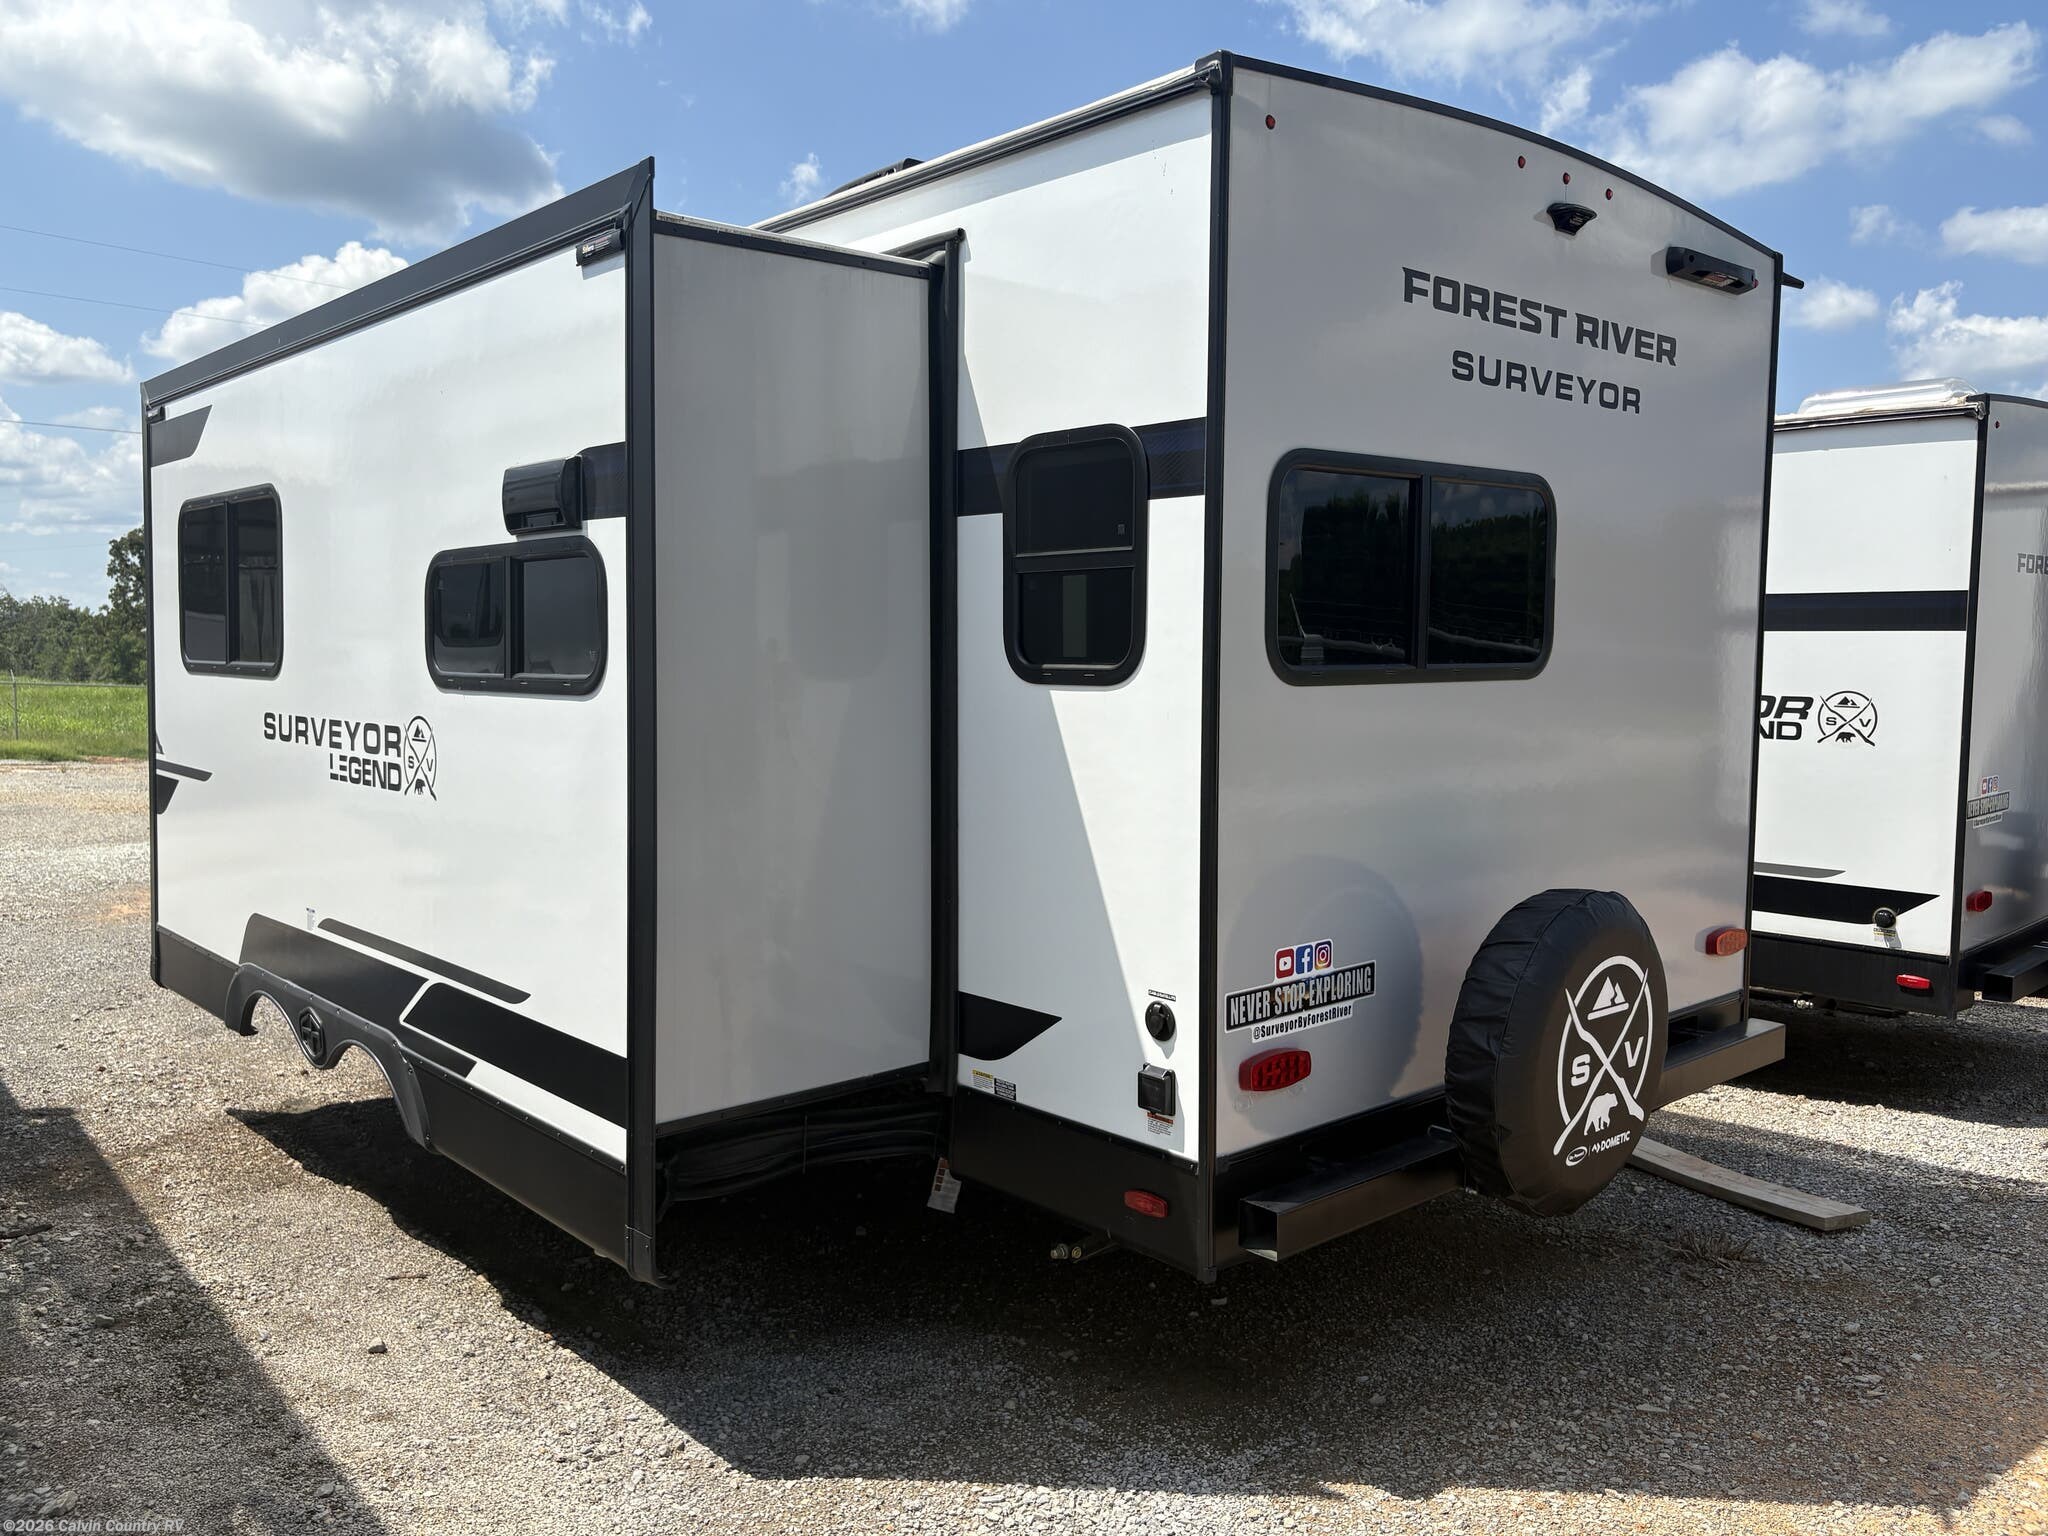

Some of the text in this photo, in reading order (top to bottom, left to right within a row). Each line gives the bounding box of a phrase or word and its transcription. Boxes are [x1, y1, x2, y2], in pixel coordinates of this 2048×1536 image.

[1402, 267, 1677, 366] FOREST RIVER
[1452, 350, 1641, 414] SURVEYOR
[263, 711, 402, 758] SURVEYOR
[329, 752, 402, 792] LEGEND
[1230, 966, 1372, 1026] NEVER STOP EXPLORING
[1253, 1005, 1352, 1040] @SurveyorByForestRiver
[1570, 1036, 1645, 1087] S V
[1600, 1131, 1631, 1152] DOMETIC
